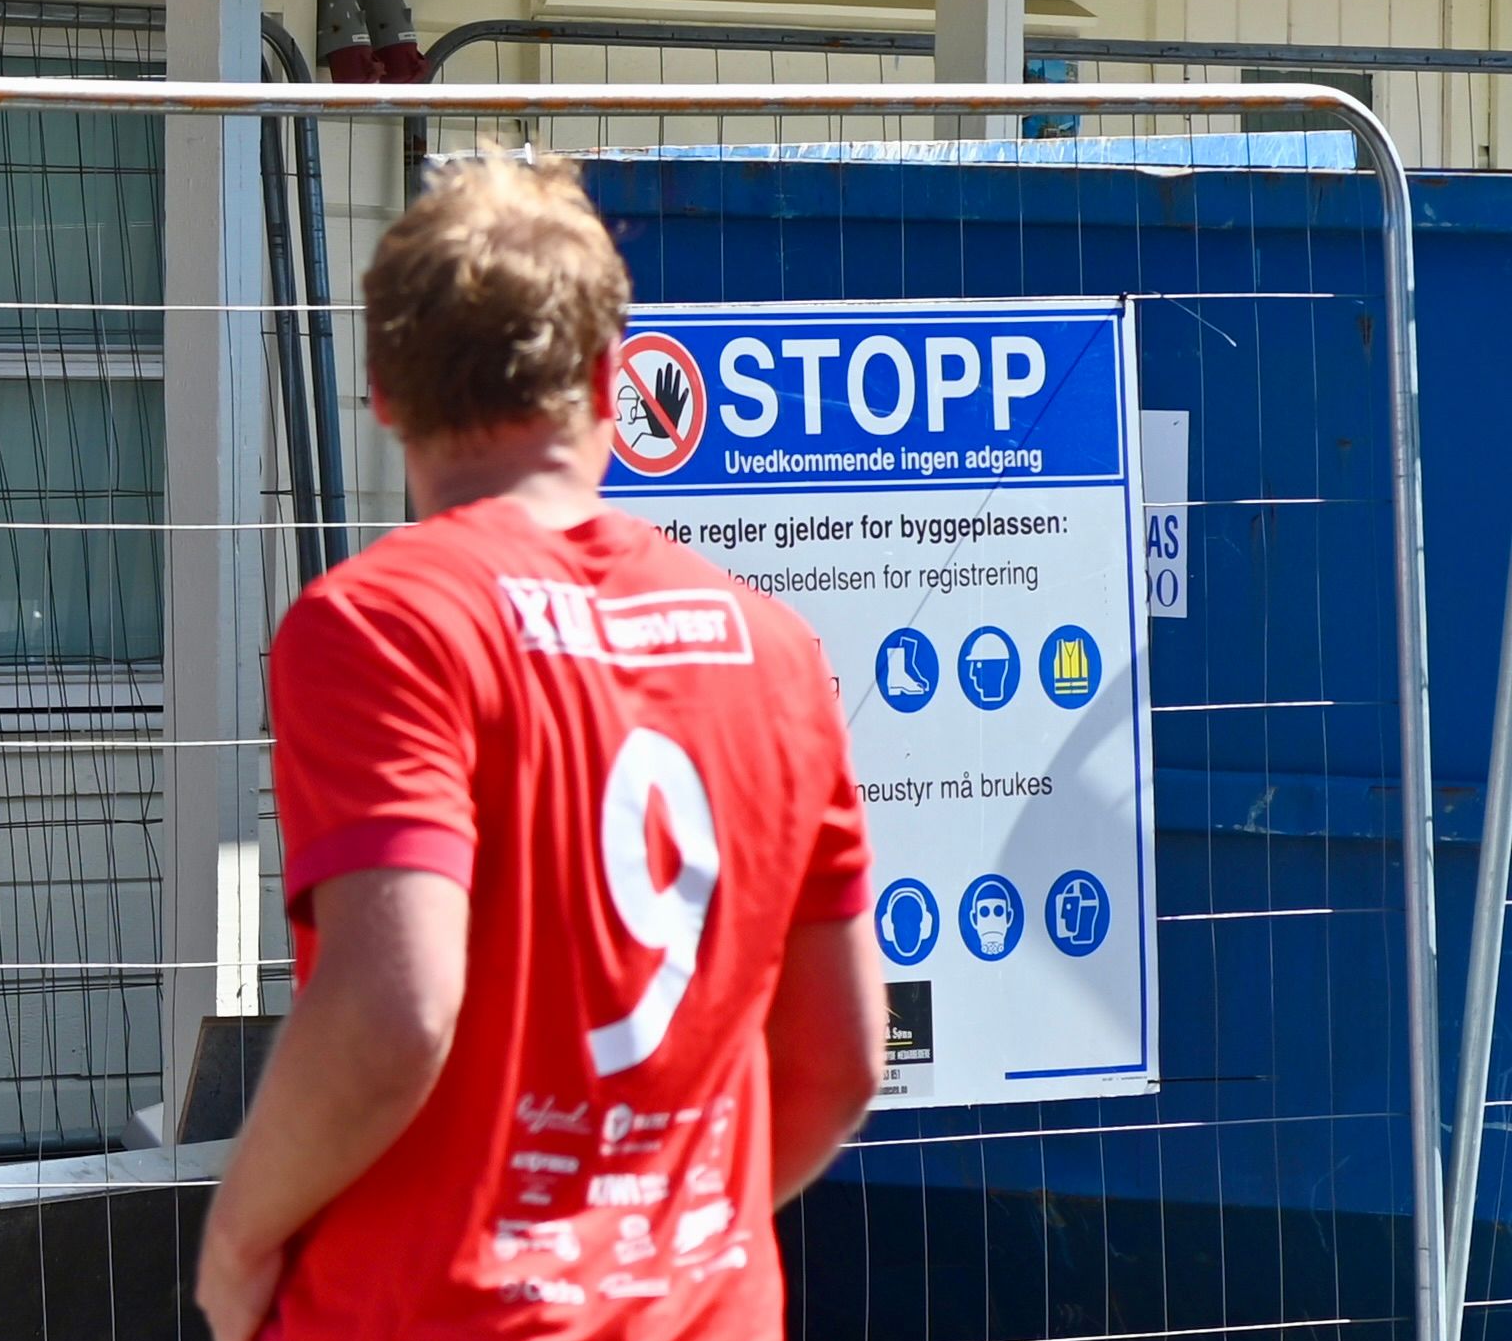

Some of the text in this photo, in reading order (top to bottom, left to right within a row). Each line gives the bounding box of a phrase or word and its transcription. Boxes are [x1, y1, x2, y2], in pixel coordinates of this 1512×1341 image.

[719, 335, 1046, 437] STOPP
[725, 446, 1042, 476] Uvedkommende ingen adgang
[700, 512, 1068, 549] regler gjelder for byggeplassen:
[1147, 515, 1179, 559] AS
[883, 561, 1038, 591] for registrering
[940, 772, 974, 799] må
[981, 773, 1053, 799] brukes
[587, 727, 719, 1077] 9
